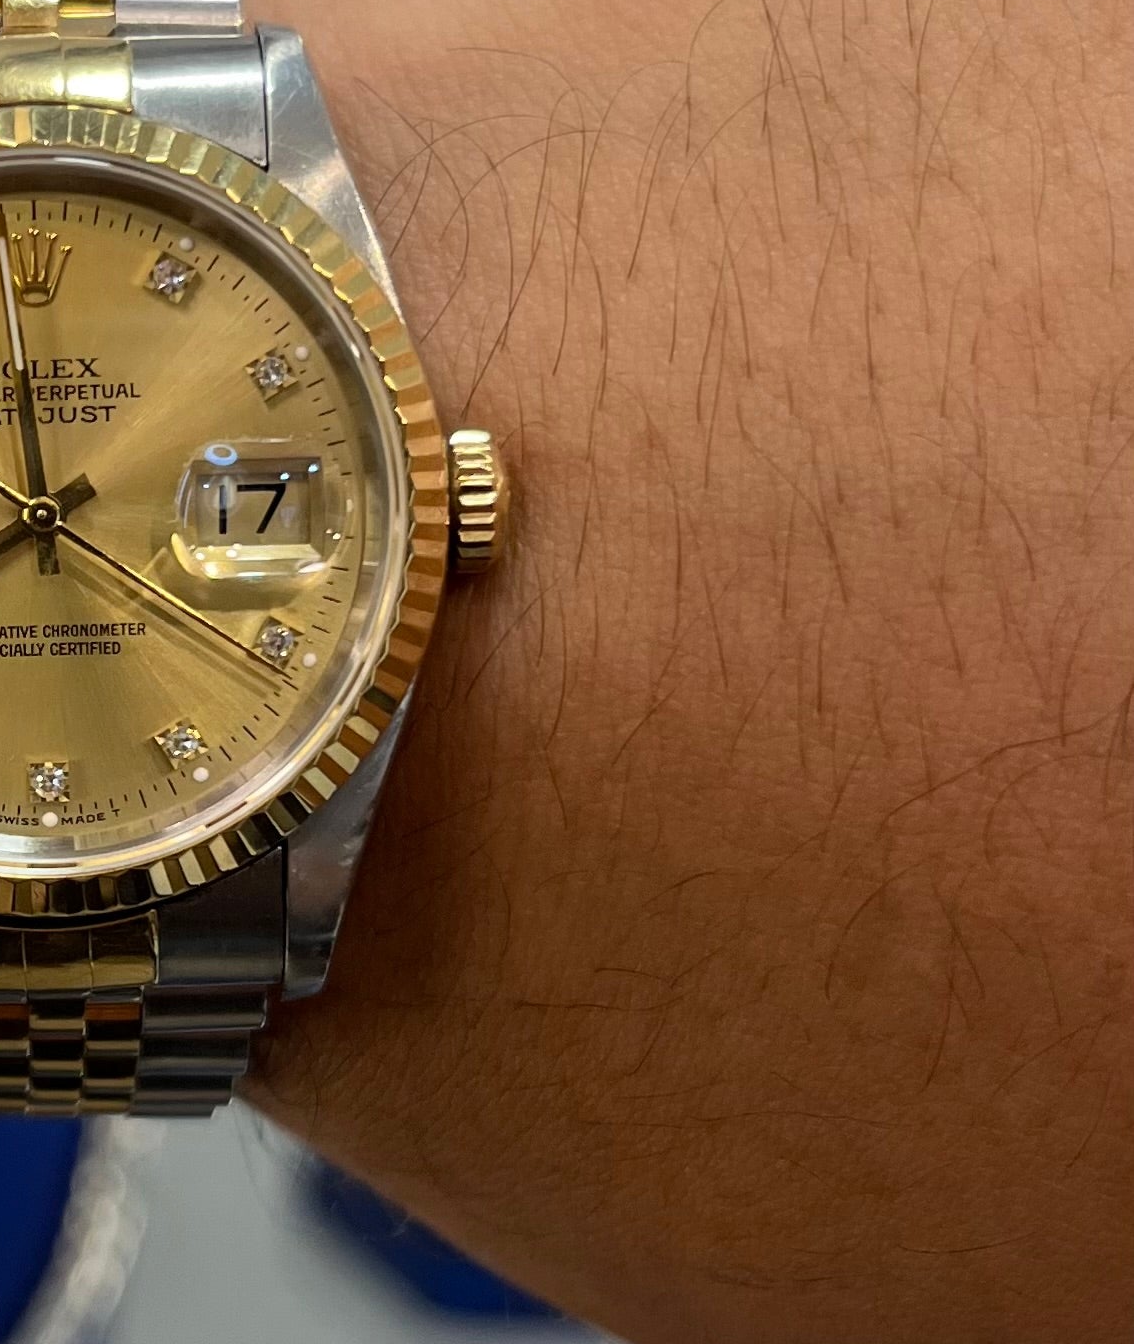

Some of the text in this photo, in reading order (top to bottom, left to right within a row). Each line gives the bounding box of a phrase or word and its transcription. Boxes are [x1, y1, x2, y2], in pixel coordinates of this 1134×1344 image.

[29, 382, 141, 402] ERPETUAL
[218, 482, 287, 535] 17
[42, 622, 147, 639] CHRONOMETER
[49, 641, 122, 657] CERTIFIED
[61, 812, 107, 826] MADE
[111, 808, 121, 818] T
